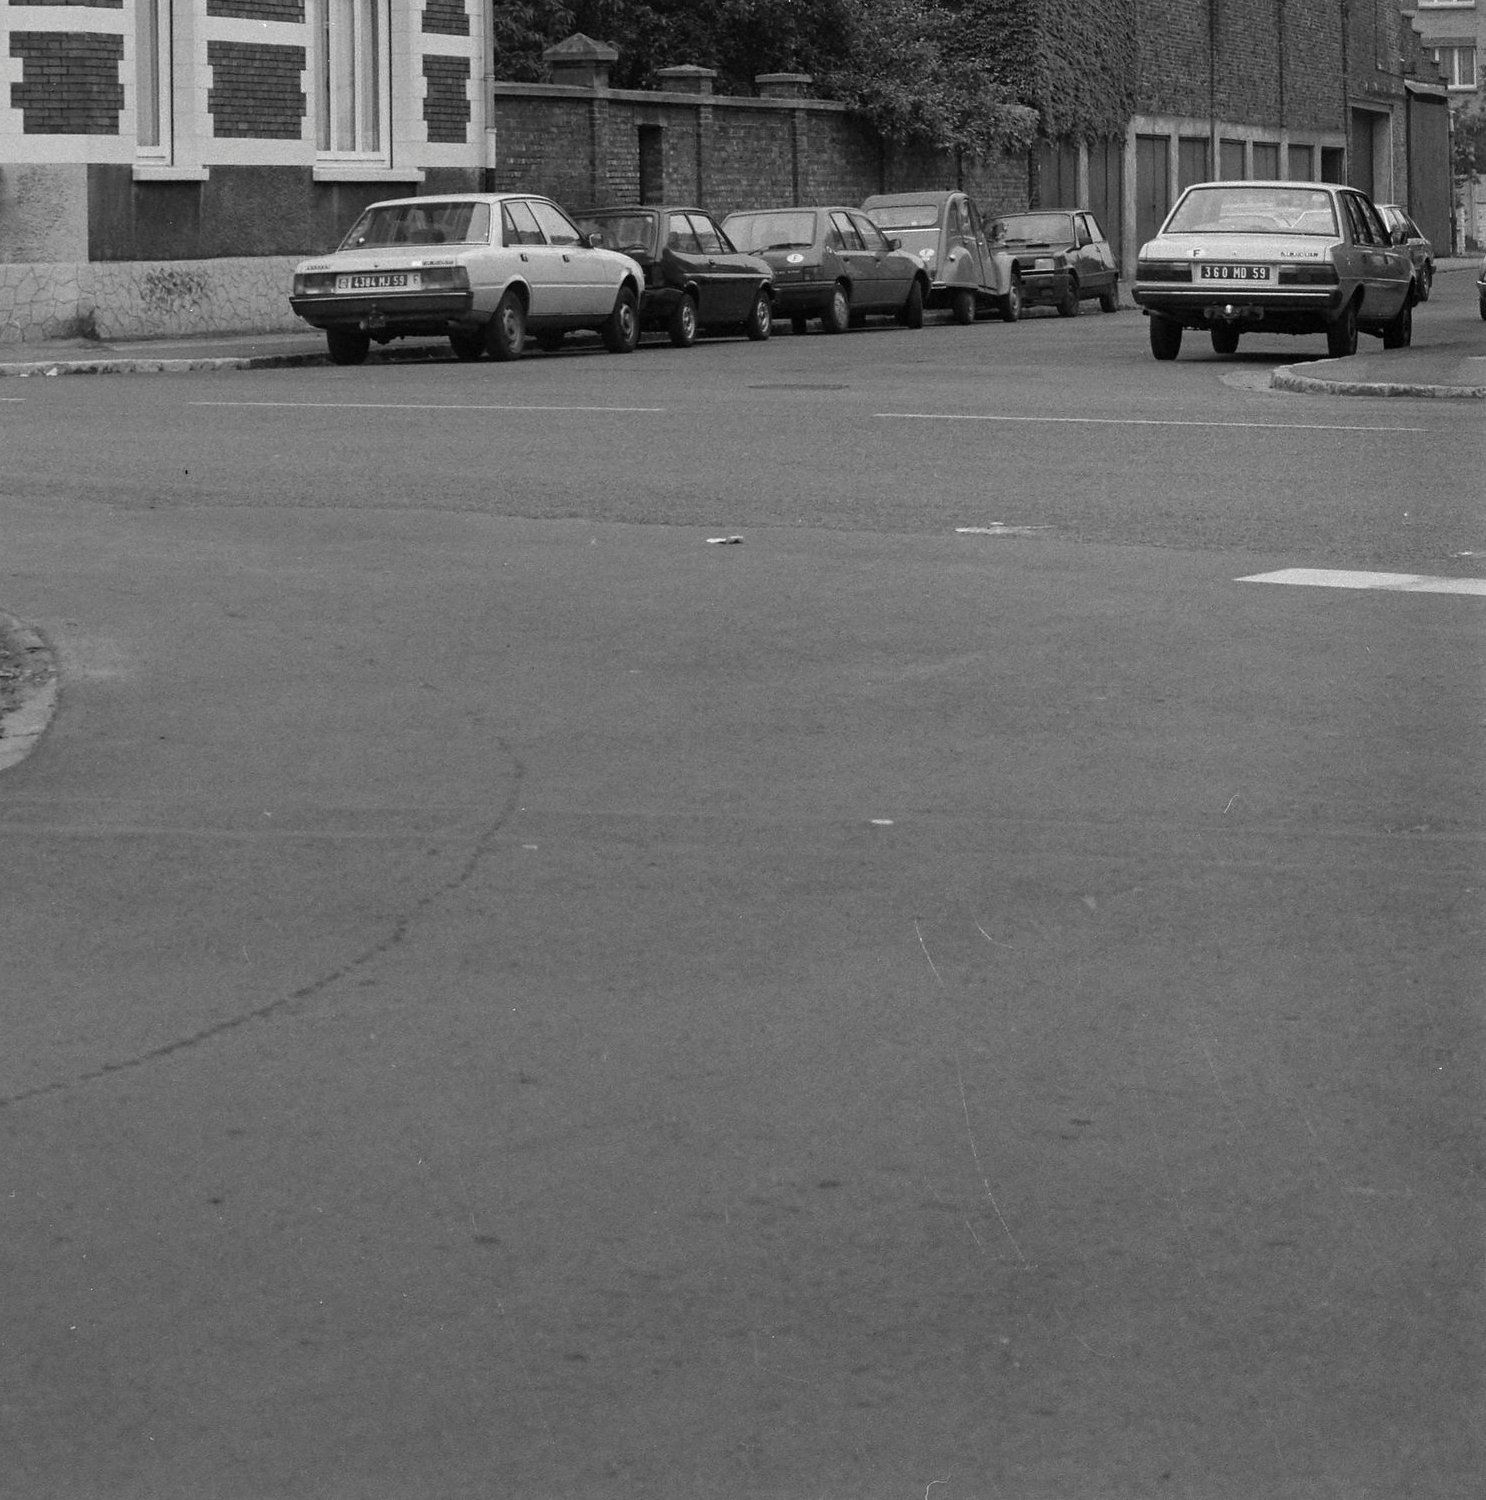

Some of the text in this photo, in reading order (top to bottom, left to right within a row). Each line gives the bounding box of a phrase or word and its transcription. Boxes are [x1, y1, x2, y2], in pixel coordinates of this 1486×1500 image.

[1193, 249, 1201, 257] F
[1204, 266, 1266, 279] 360 MD 59
[378, 276, 391, 287] MJ
[394, 275, 405, 286] 59
